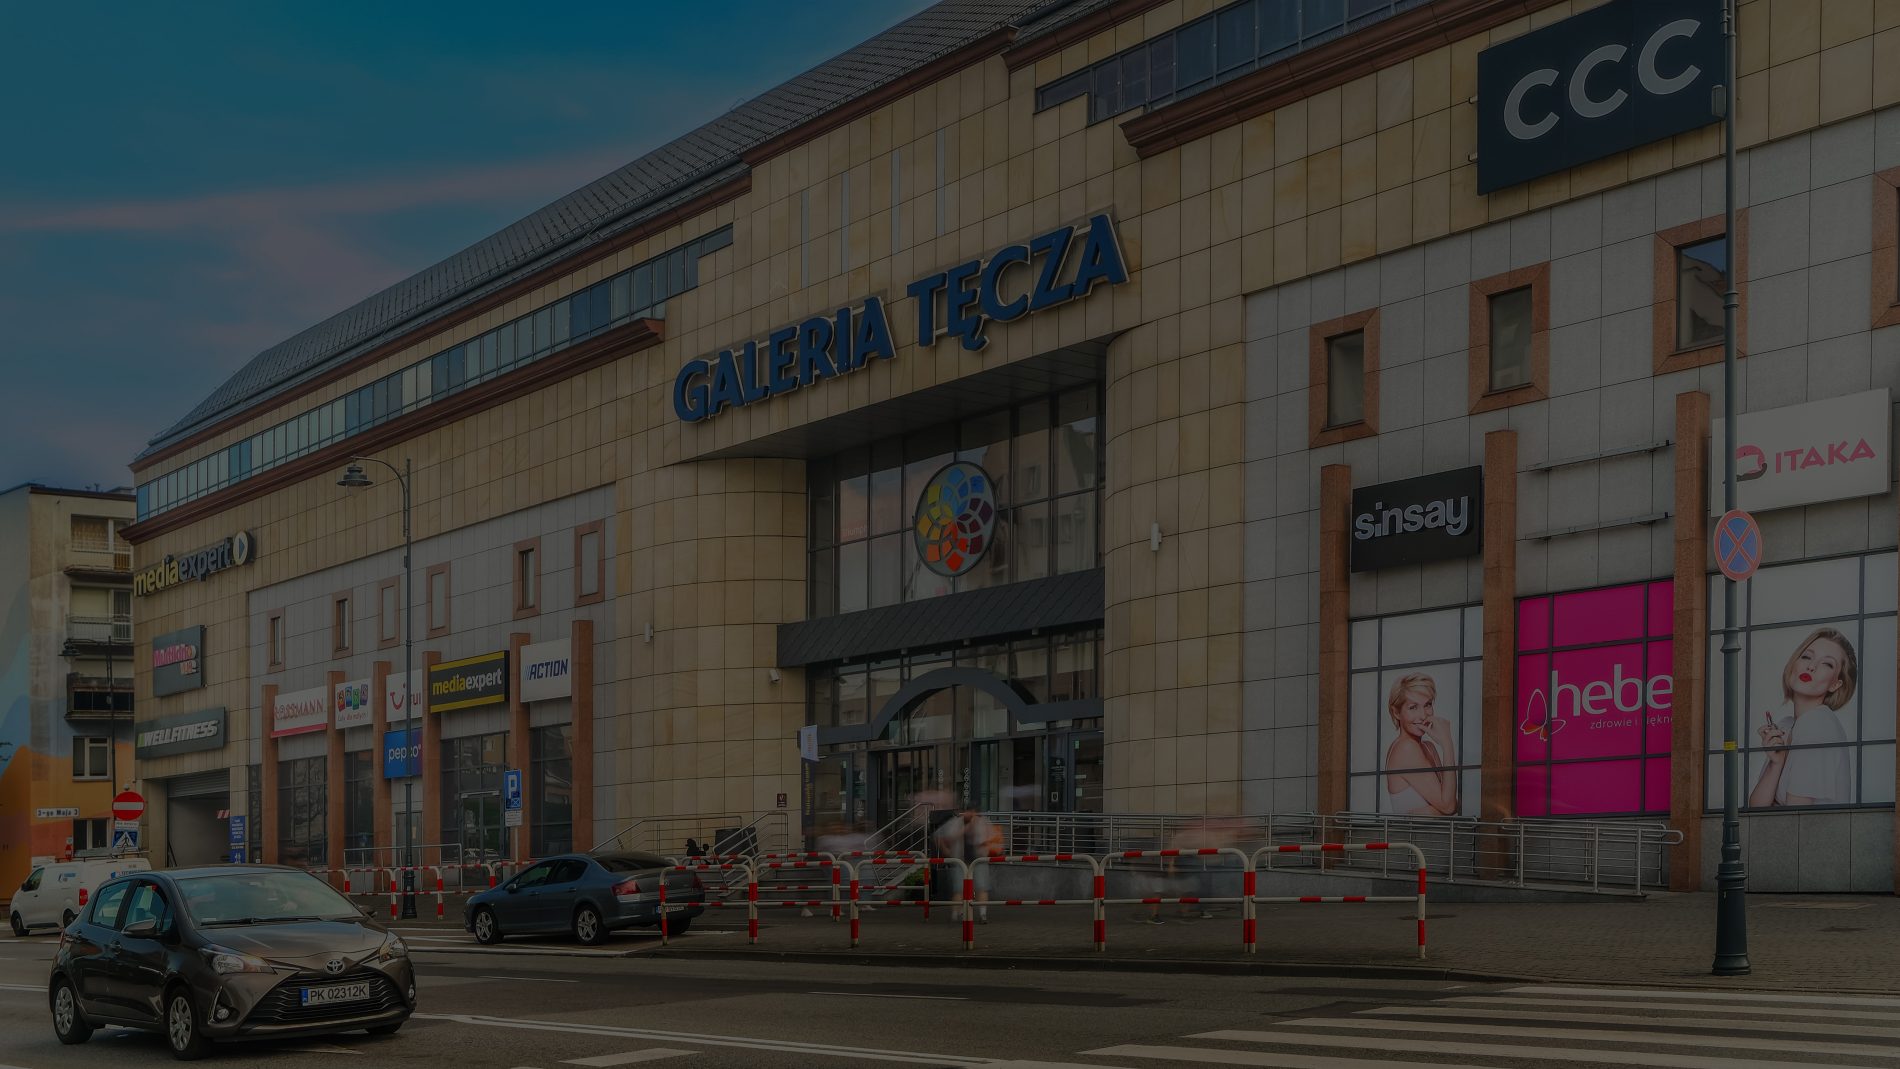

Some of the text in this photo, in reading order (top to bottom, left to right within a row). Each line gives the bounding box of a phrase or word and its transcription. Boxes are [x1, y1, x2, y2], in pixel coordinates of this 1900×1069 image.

[1503, 18, 1702, 141] CCC
[673, 213, 1130, 424] GALERIA TĘCZA
[1774, 437, 1877, 475] ITAKA
[1354, 494, 1470, 541] sinsay
[133, 536, 234, 597] mediaexpert
[432, 668, 502, 696] mediaexpert
[529, 658, 569, 681] ACTION
[1552, 663, 1674, 718] hebe
[1590, 718, 1631, 730] zdrowie
[388, 744, 419, 764] pepo
[310, 984, 366, 1001] PK 02312K
